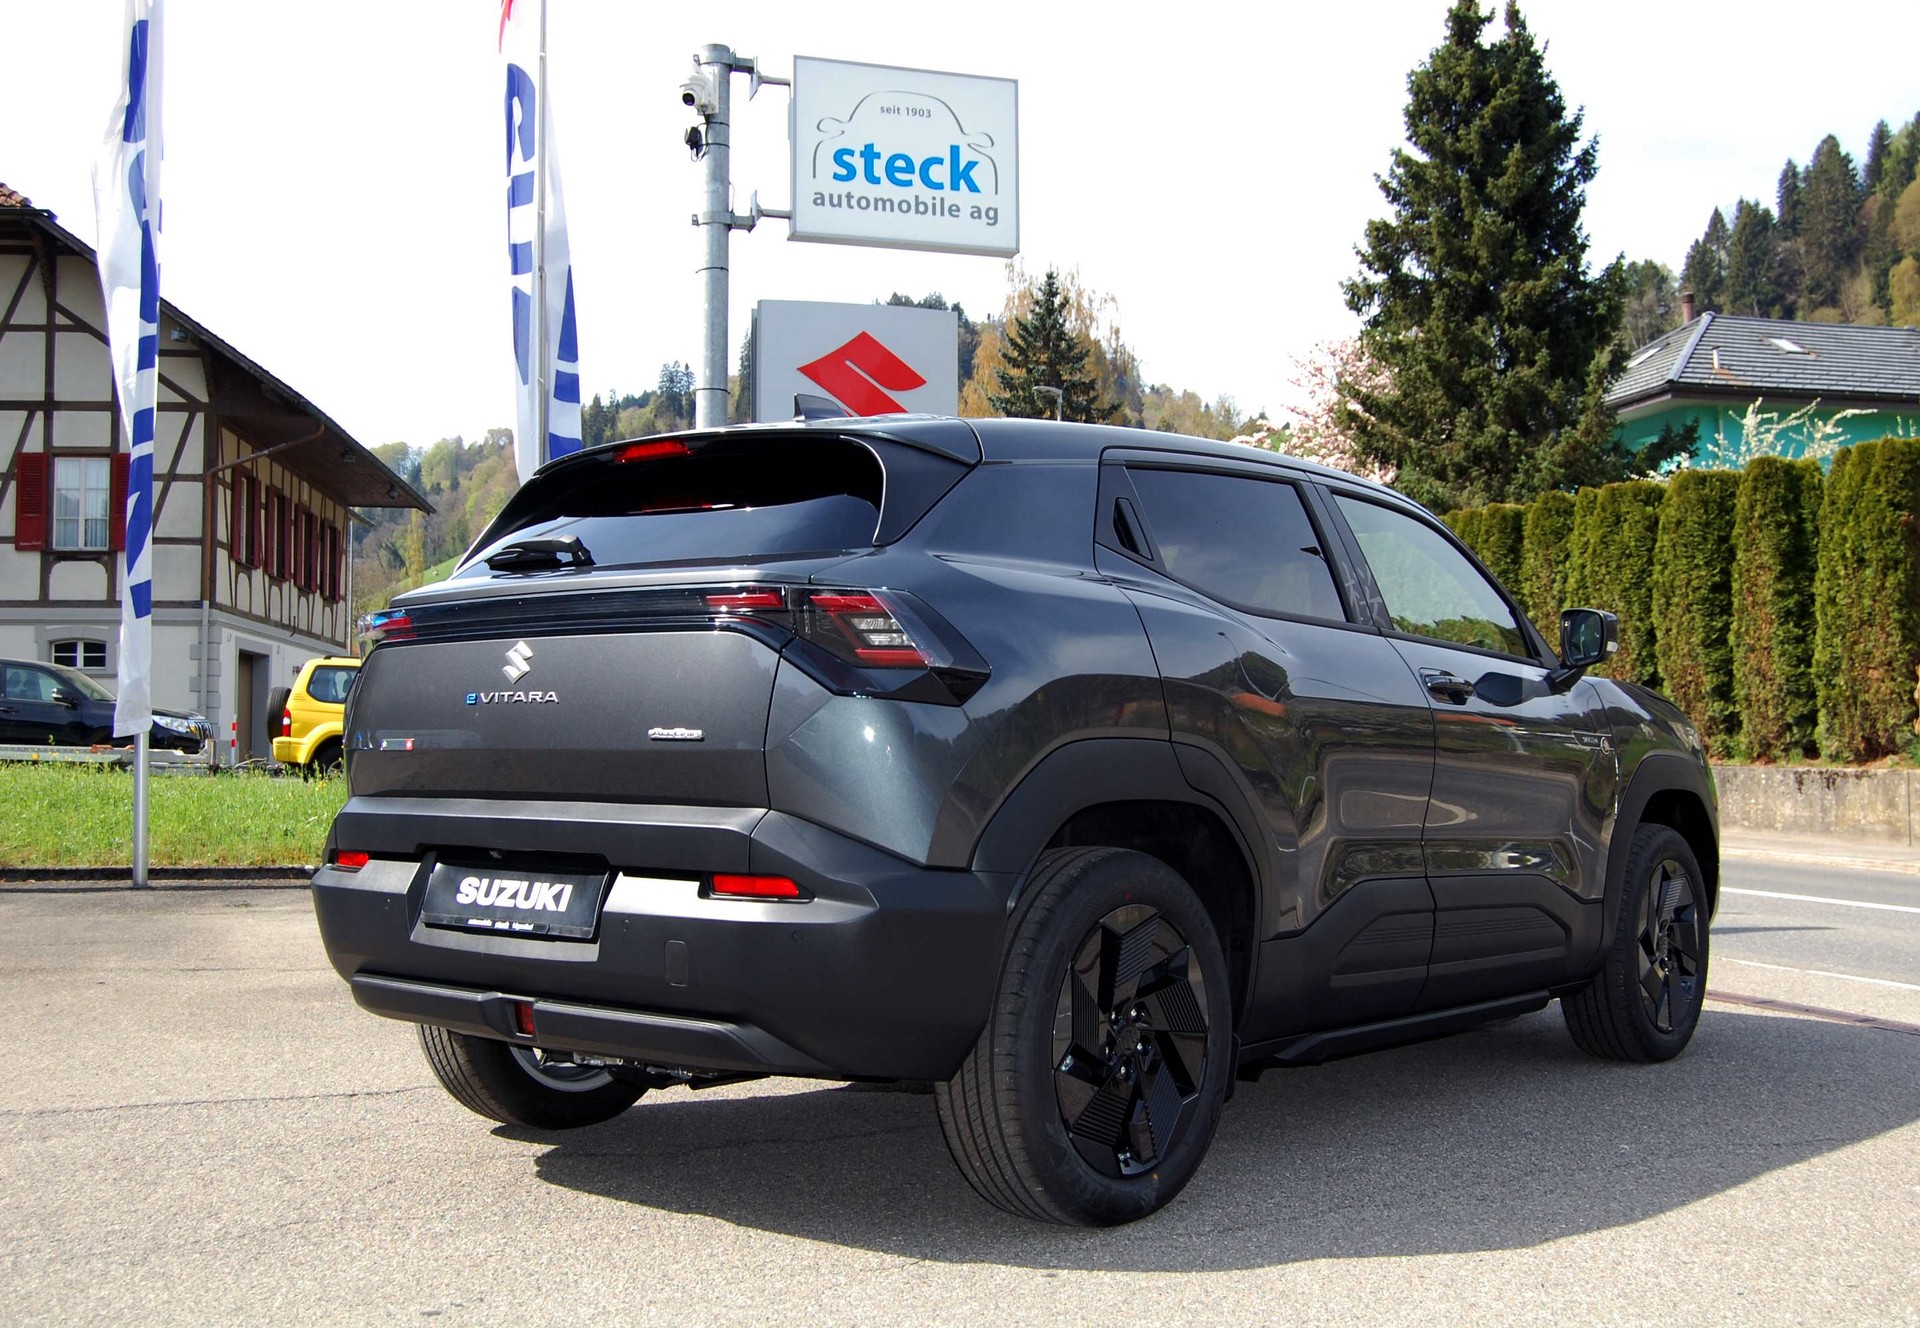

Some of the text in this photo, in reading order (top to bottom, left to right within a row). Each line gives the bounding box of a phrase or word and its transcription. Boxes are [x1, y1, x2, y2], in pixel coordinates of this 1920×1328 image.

[880, 104, 932, 119] seit 1903
[832, 142, 982, 194] steck
[812, 191, 999, 227] automobile ag
[456, 876, 573, 912] SUZUKI
